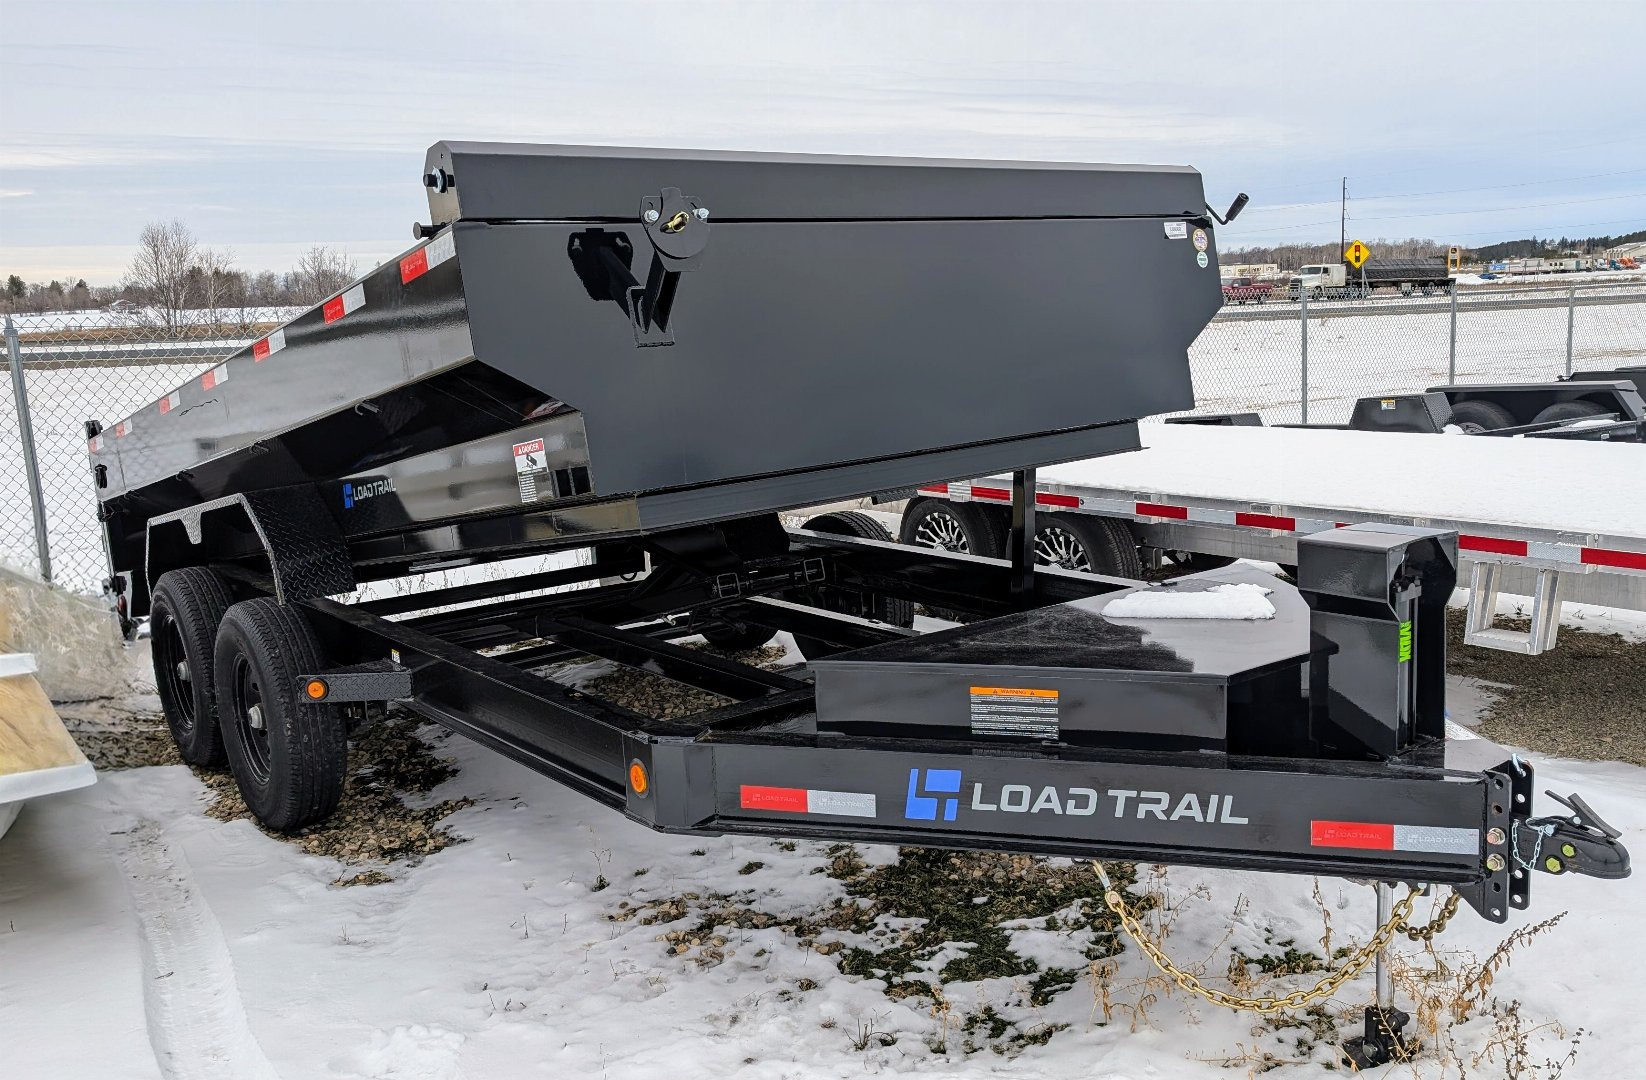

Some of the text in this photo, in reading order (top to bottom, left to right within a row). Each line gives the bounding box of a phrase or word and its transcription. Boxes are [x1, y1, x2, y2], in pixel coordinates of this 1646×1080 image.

[353, 478, 397, 501] LOAD TRAIL
[971, 783, 1249, 824] LOAD TRAIL
